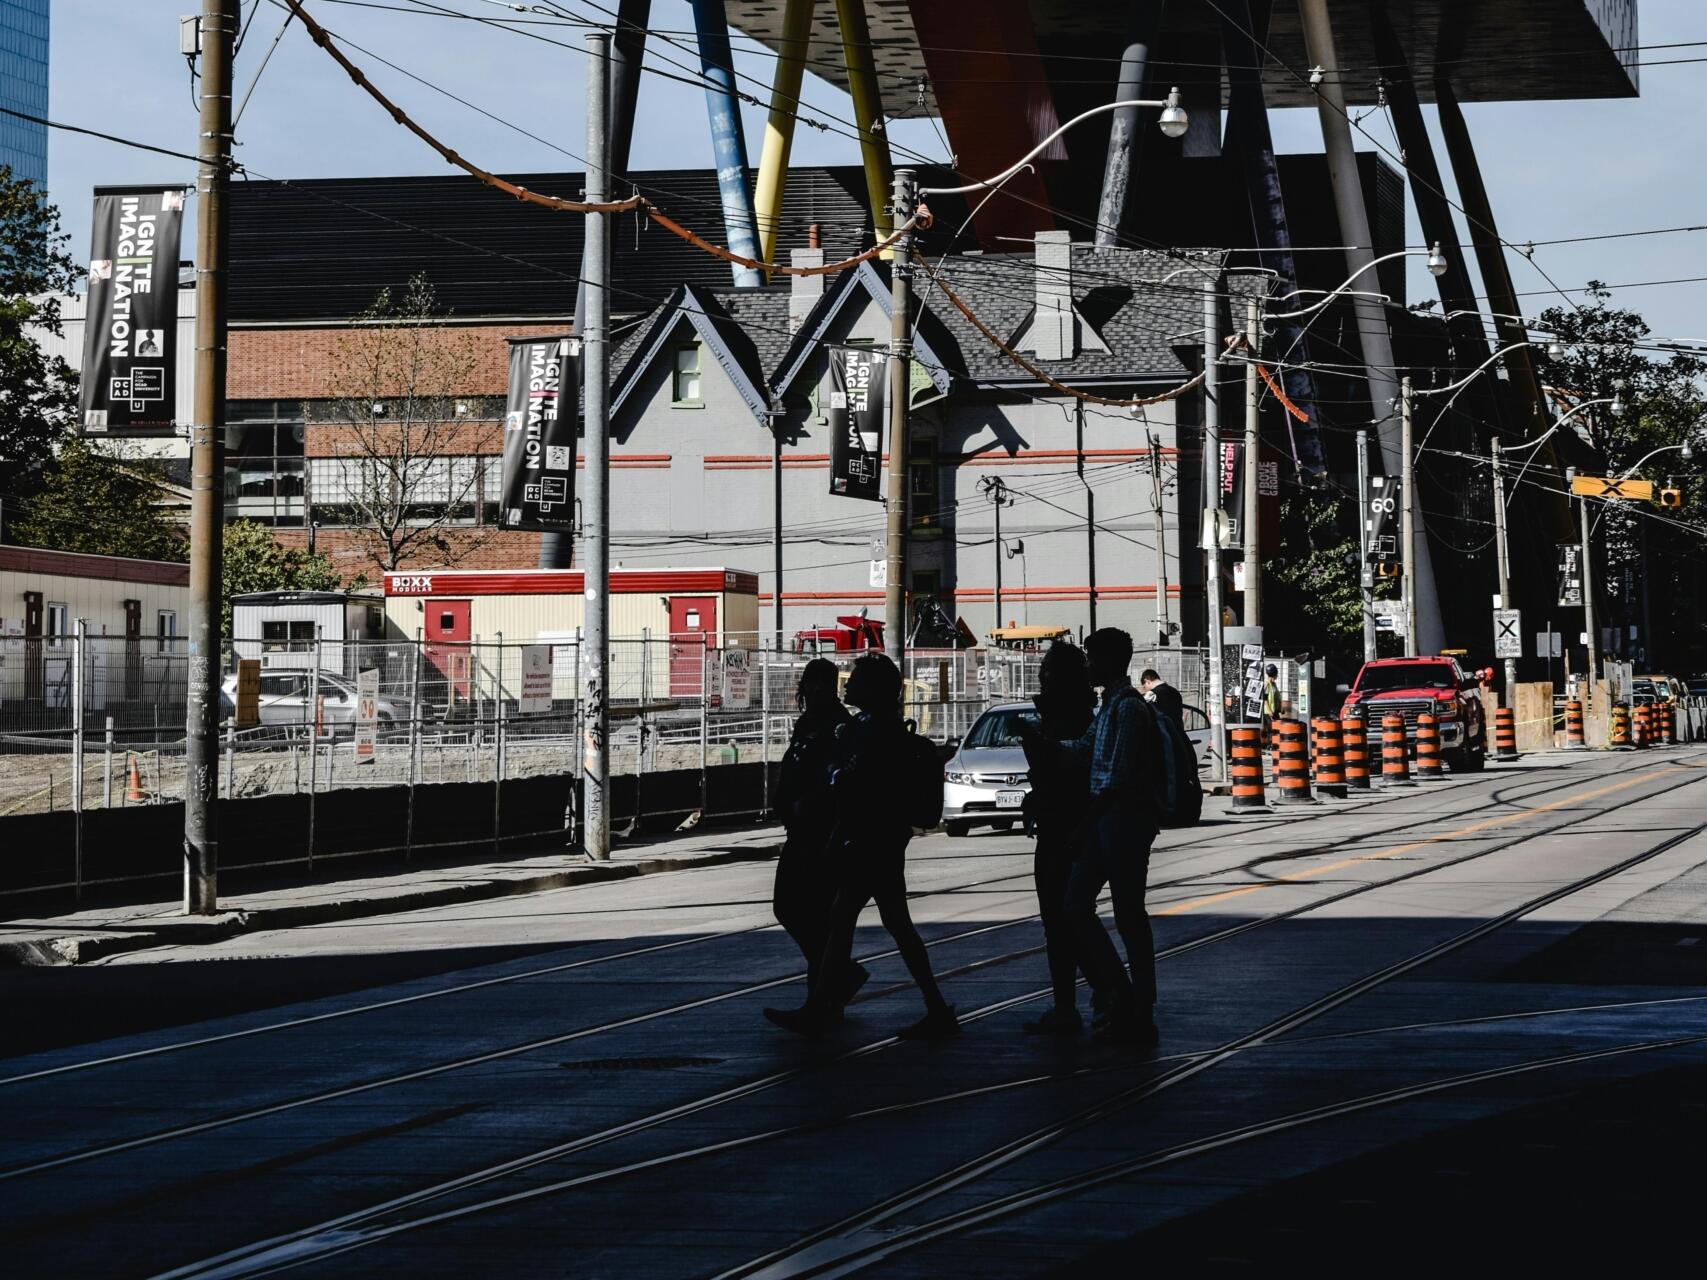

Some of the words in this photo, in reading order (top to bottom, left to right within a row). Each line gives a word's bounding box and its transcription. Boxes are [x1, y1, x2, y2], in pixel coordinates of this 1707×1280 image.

[133, 215, 156, 294] IGNITE
[110, 197, 139, 357] IMAGINATION
[543, 358, 560, 421] IGNITE
[856, 362, 871, 412] IGNITE
[525, 344, 546, 470] IMAGINATION
[1224, 443, 1234, 471] HELP
[1224, 472, 1234, 493] PUT
[1259, 461, 1270, 496] ABOVE
[1269, 461, 1279, 496] GROUND
[1371, 497, 1395, 513] 60
[392, 577, 432, 587] BOXX
